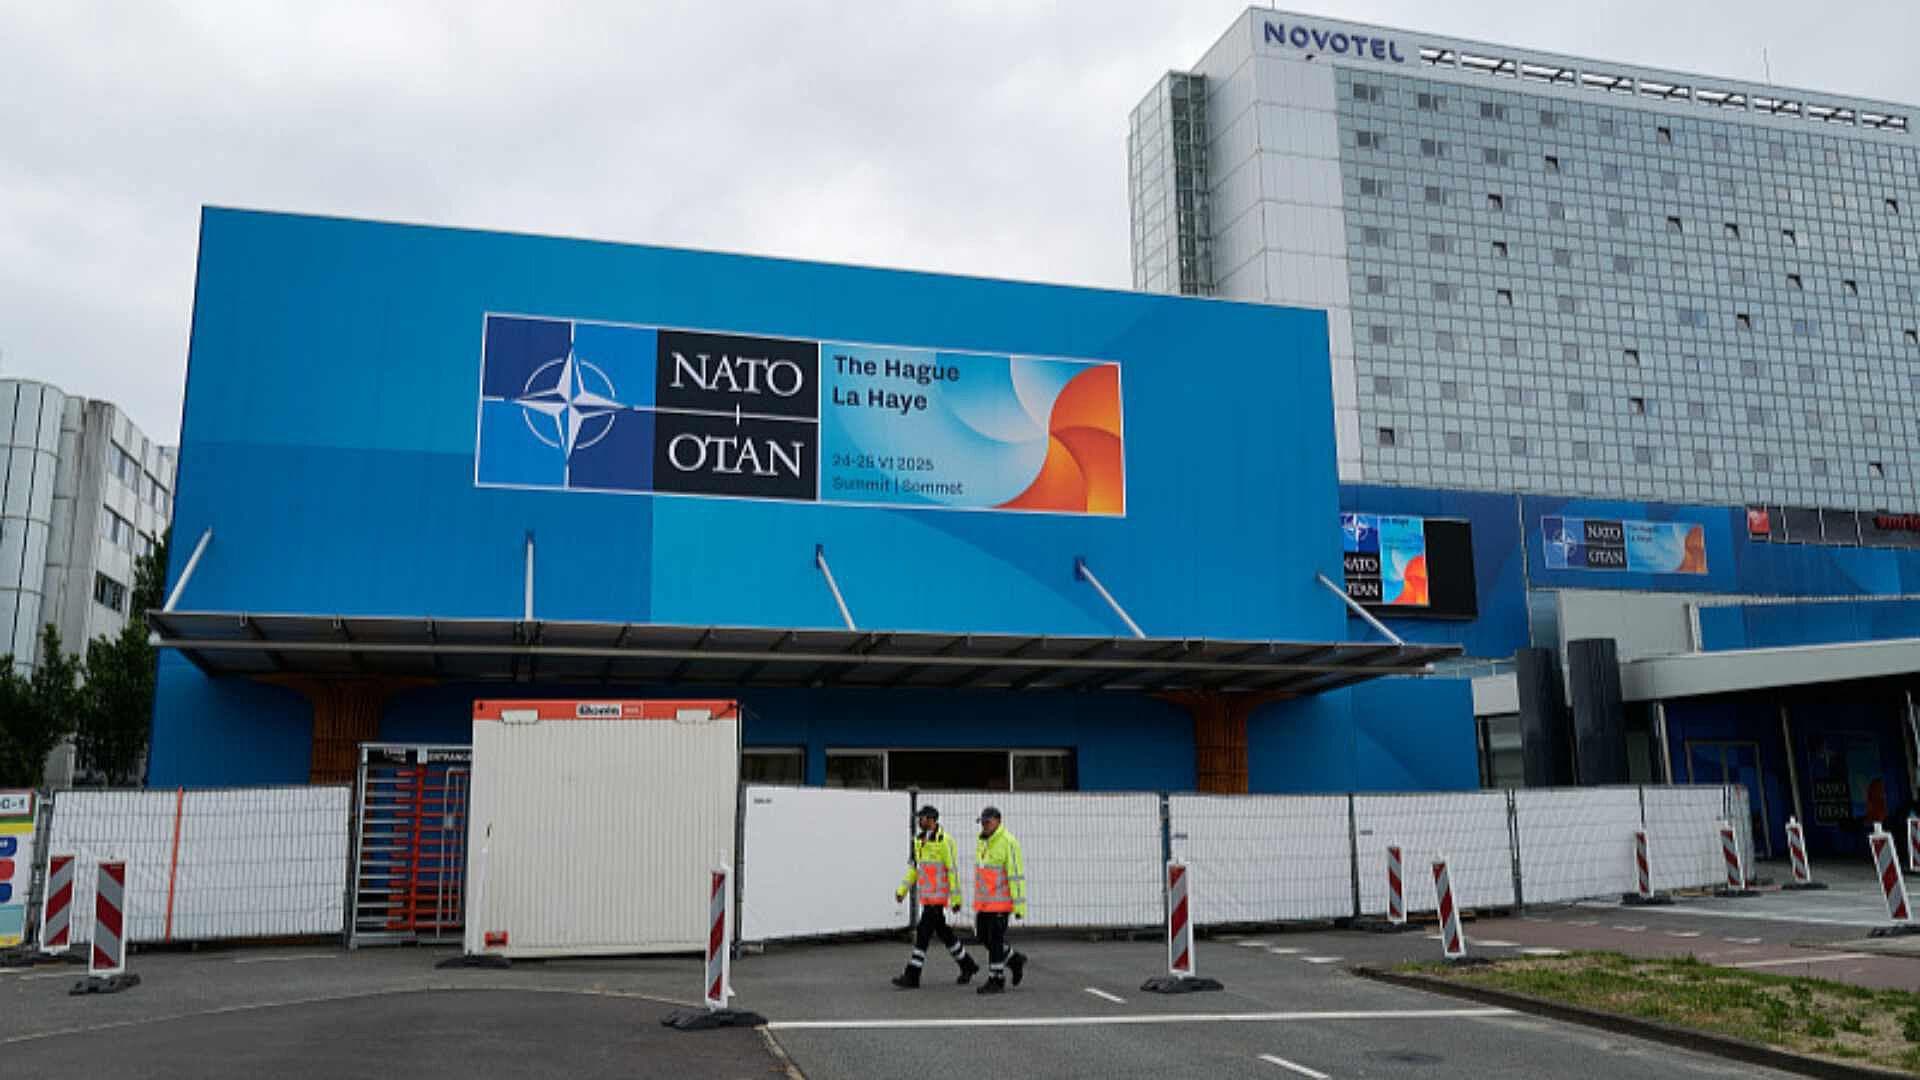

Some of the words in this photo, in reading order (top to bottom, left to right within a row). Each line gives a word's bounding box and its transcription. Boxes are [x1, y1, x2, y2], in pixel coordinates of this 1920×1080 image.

[1263, 20, 1405, 63] NOVOTEL
[670, 351, 803, 397] NATO
[834, 354, 877, 377] The
[885, 359, 960, 385] Hague
[832, 385, 860, 407] La
[868, 388, 928, 416] Haye
[668, 433, 804, 480] OTAN
[897, 455, 935, 472] 2025
[831, 475, 889, 493] Summit
[902, 479, 963, 497] Sommet
[1345, 580, 1379, 597] TAN
